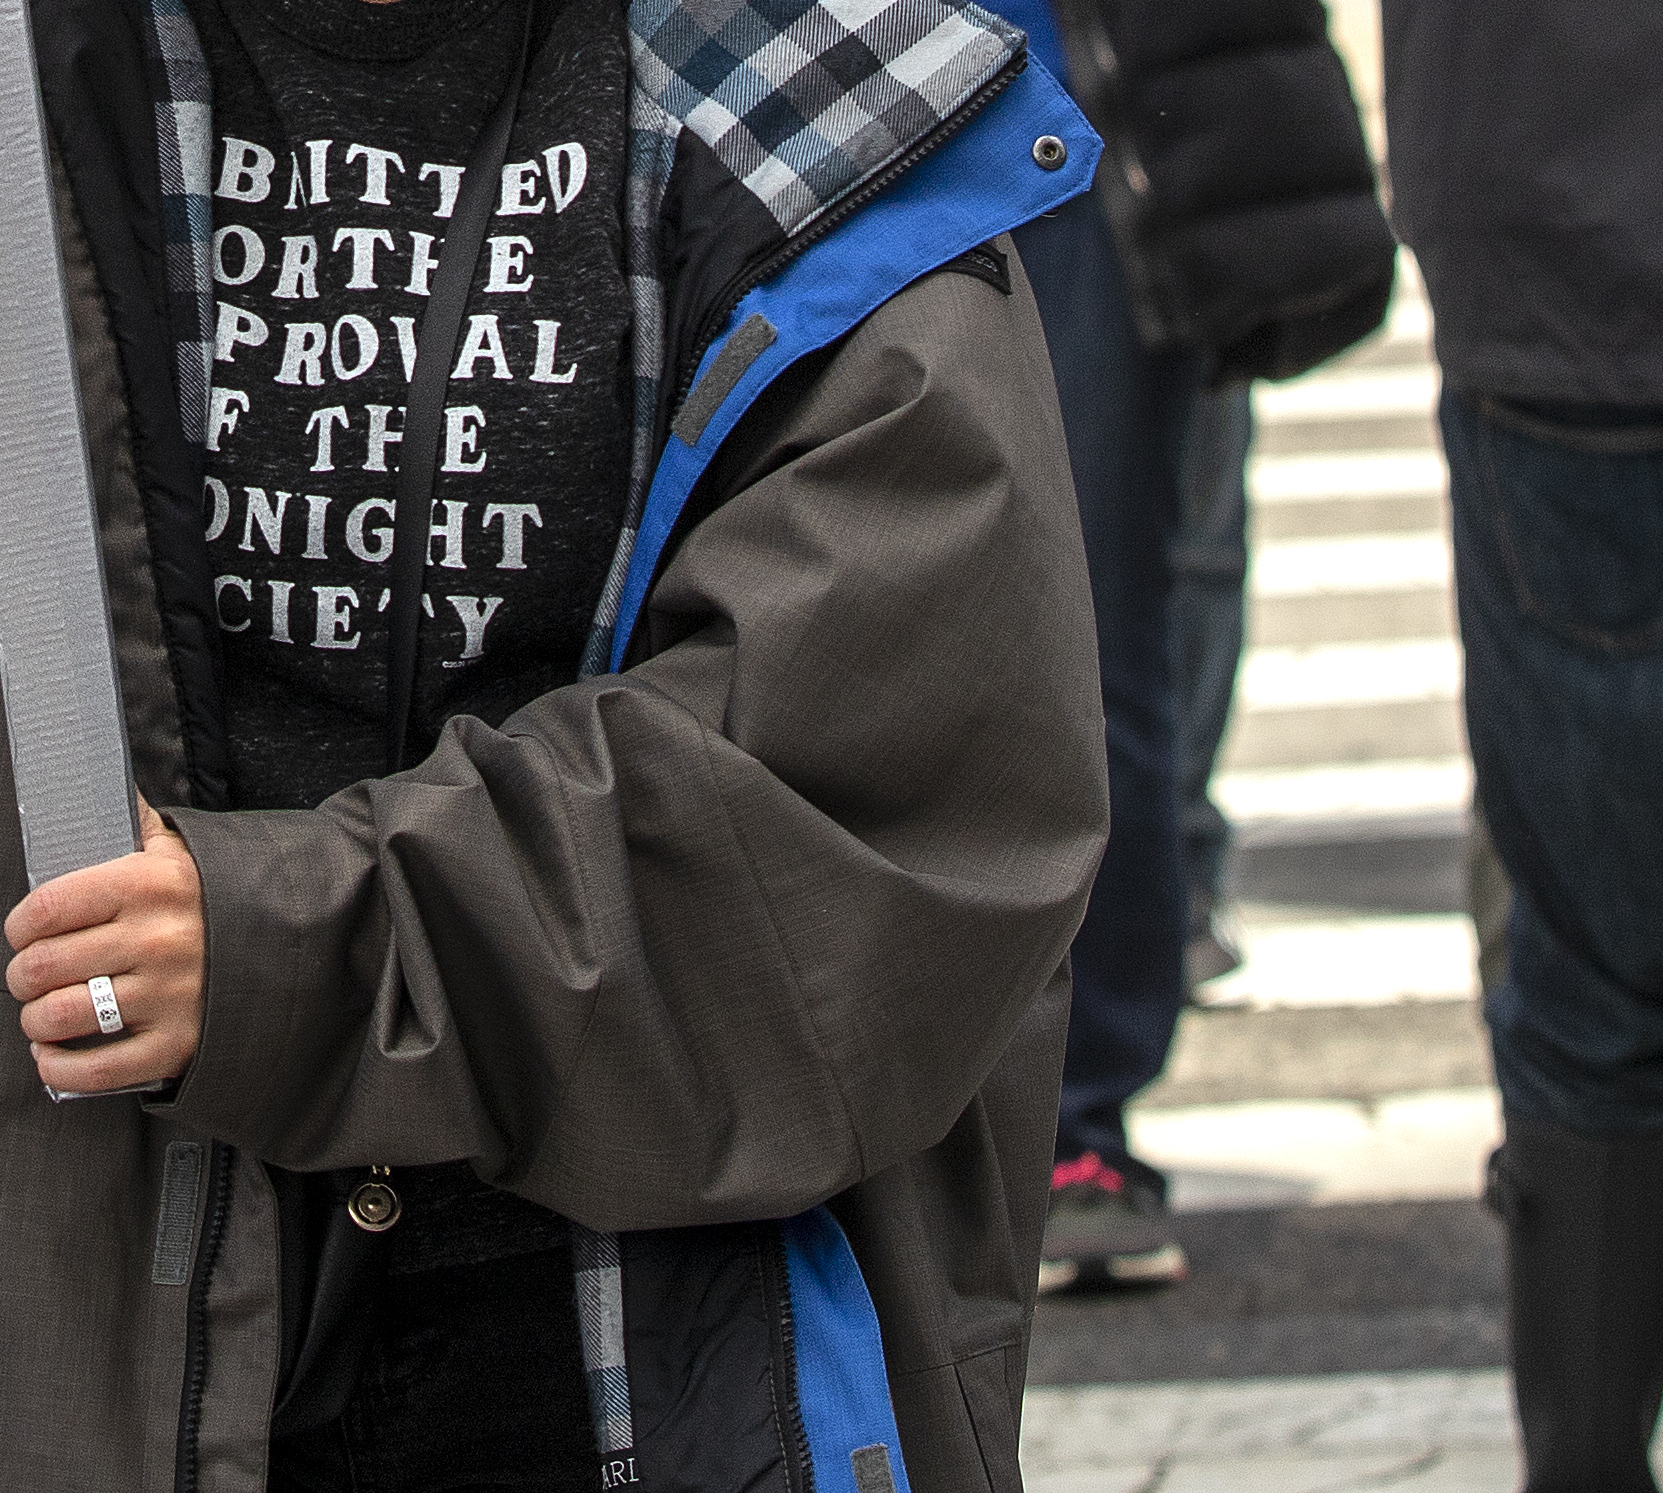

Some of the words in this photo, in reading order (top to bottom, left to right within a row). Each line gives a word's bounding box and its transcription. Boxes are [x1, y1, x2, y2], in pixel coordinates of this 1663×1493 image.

[208, 387, 251, 452] F
[305, 404, 488, 473] THE
[214, 574, 503, 658] CIEY
